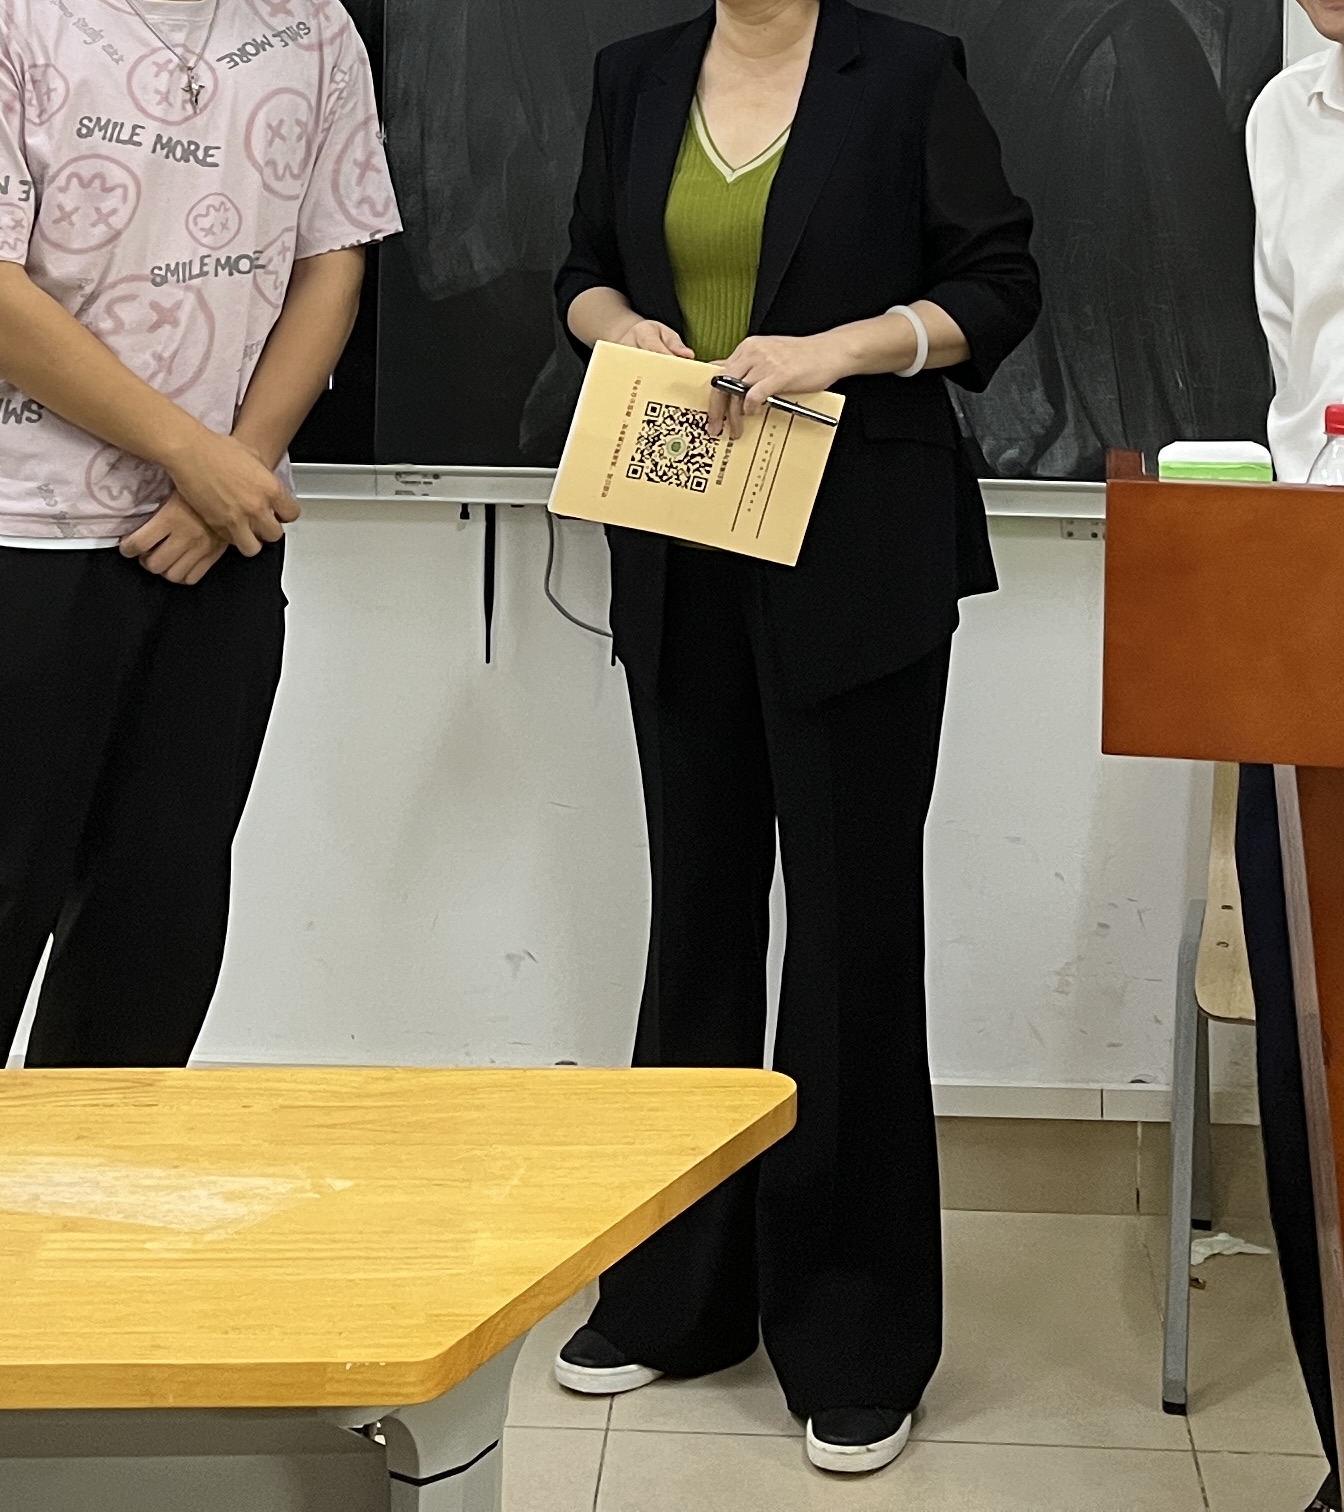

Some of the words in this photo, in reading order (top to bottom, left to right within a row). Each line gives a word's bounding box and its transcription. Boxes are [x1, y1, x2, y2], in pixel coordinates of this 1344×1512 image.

[272, 21, 311, 48] SMILE
[216, 34, 274, 70] MORE
[76, 115, 145, 147] SMILE
[151, 133, 222, 168] MORE
[150, 254, 212, 287] SMILE
